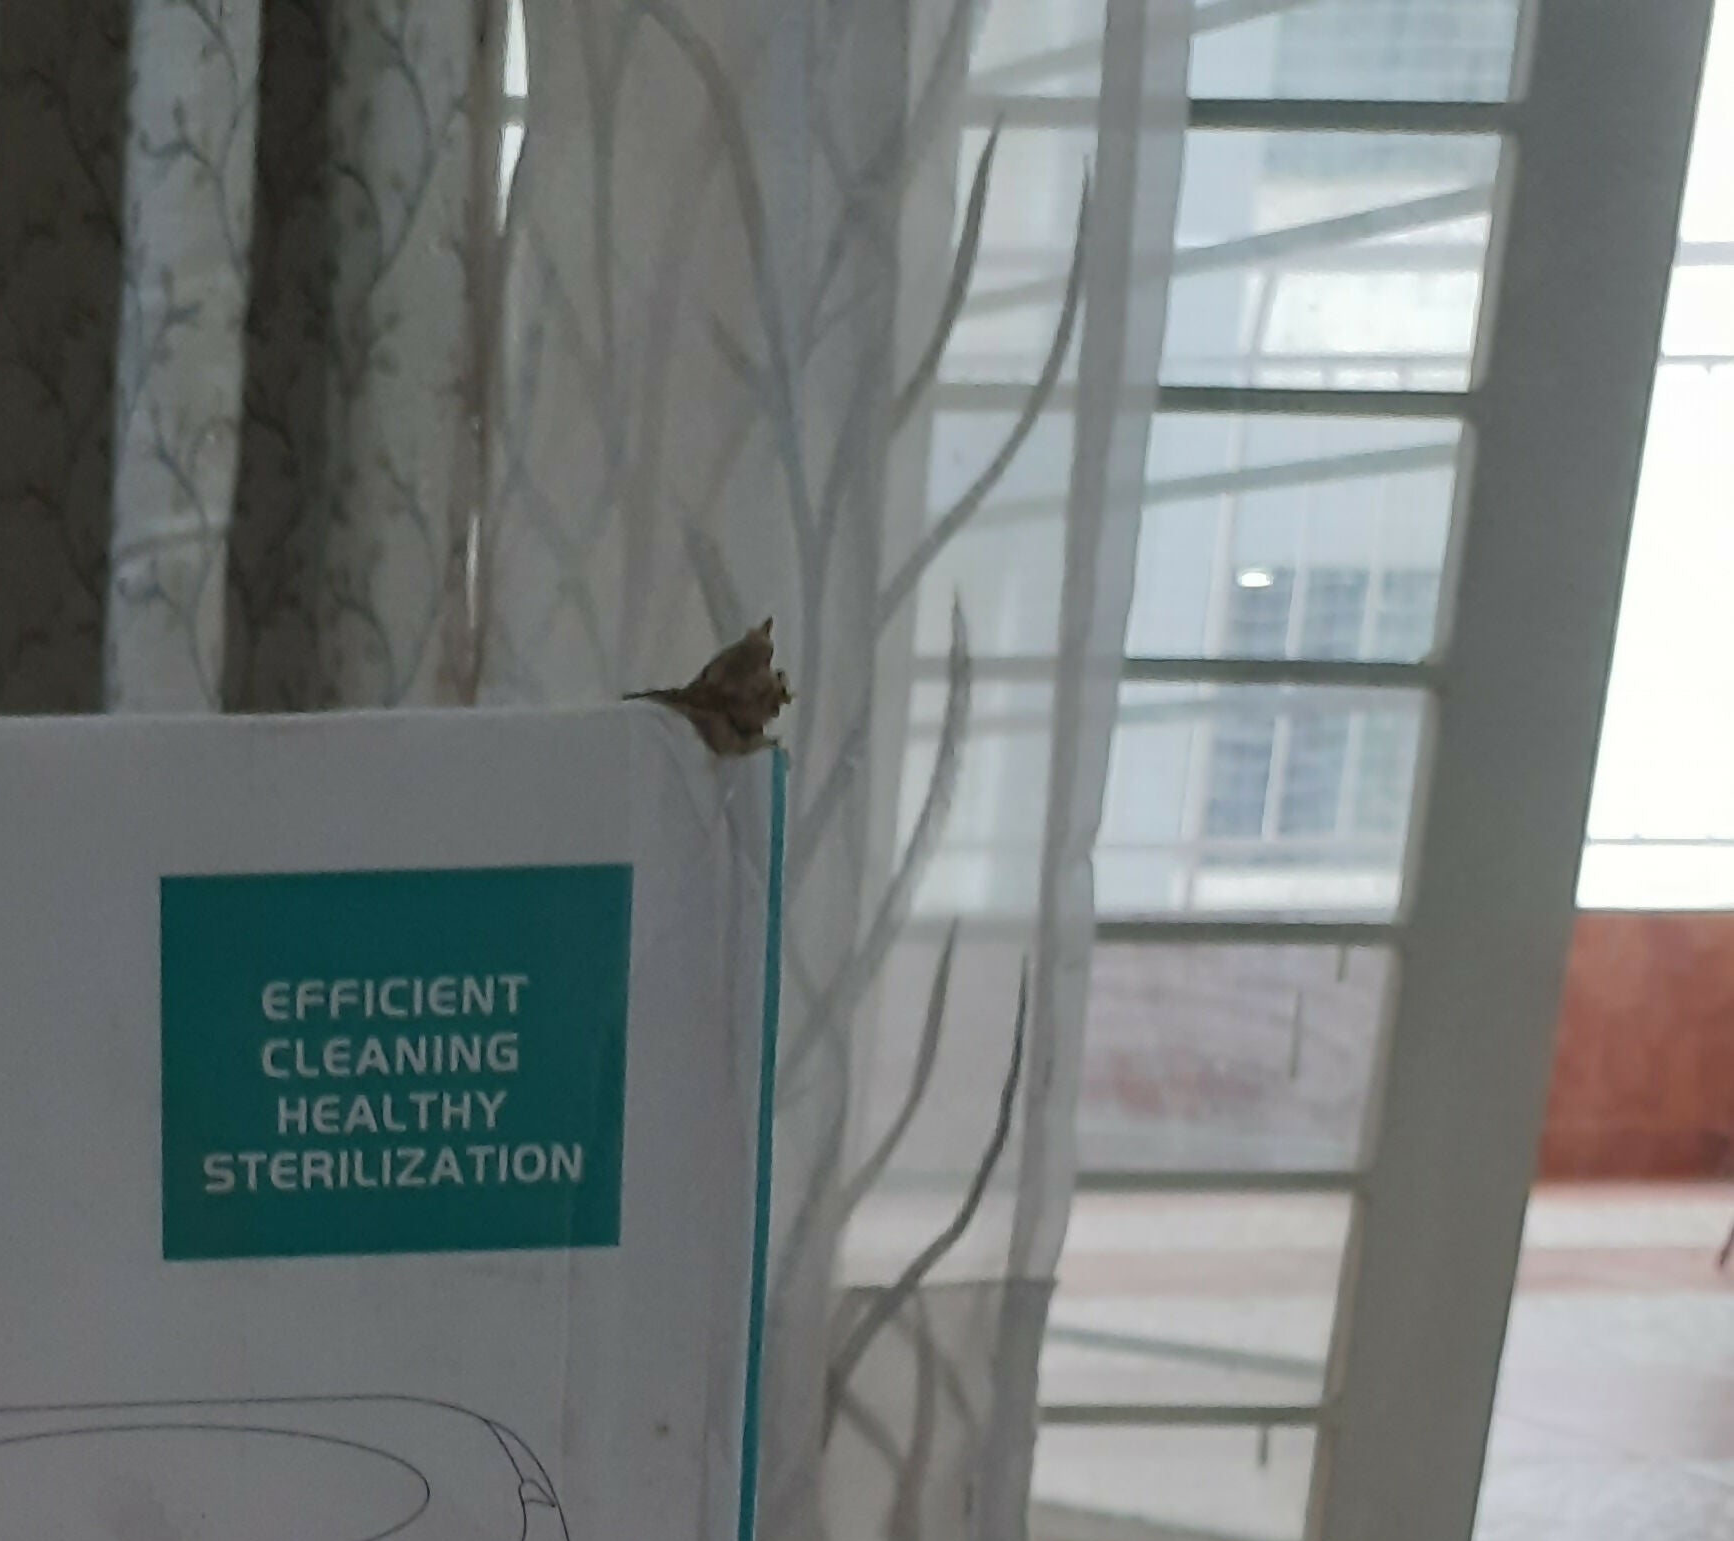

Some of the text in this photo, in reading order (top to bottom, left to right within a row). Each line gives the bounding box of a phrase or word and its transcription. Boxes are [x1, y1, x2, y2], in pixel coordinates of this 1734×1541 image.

[261, 974, 530, 1022] EFFICIENT
[261, 1032, 521, 1080] CLEANING
[277, 1090, 509, 1136] HEALTHY
[203, 1143, 585, 1194] STERILIZATION
